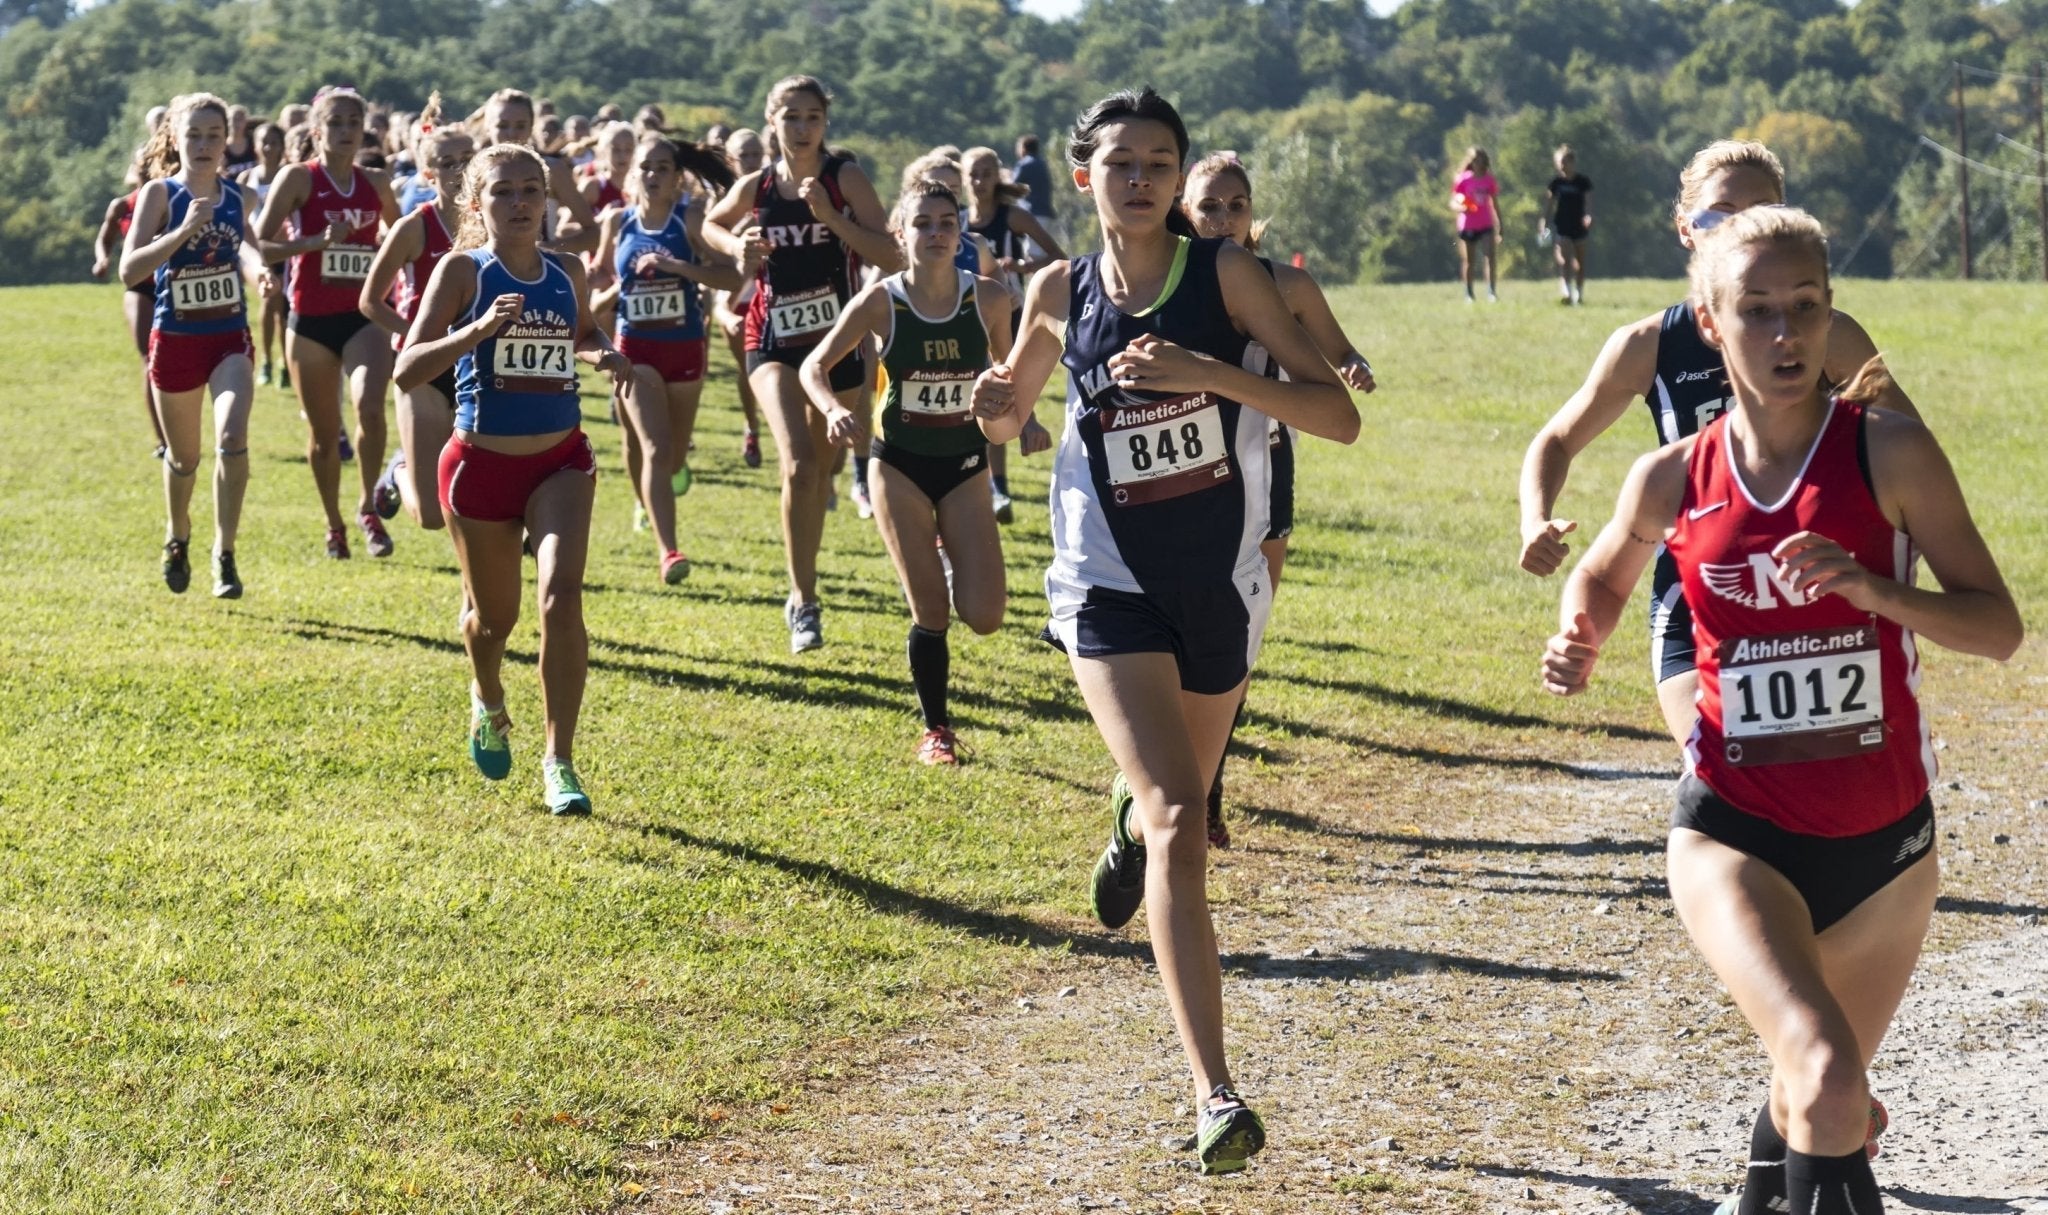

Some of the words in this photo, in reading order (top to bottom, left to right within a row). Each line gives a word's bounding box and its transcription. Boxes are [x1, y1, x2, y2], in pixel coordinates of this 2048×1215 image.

[342, 208, 362, 229] N
[767, 223, 830, 247] RYE
[177, 263, 232, 279] Athletic.net
[328, 253, 372, 274] 1002
[180, 278, 234, 304] 1080
[775, 286, 831, 307] Athletic.net
[633, 295, 679, 315] 1074
[779, 300, 835, 331] 1230
[504, 324, 570, 337] Athletic.net
[504, 343, 567, 372] 1073
[924, 338, 961, 361] FDR
[909, 370, 974, 381] Athletic.net
[1686, 371, 1710, 381] asics
[918, 384, 962, 408] 444
[1111, 391, 1207, 429] Athletic.net
[1129, 422, 1203, 471] 848
[1748, 553, 1806, 610] N
[1731, 629, 1865, 664] Athletic.net
[1737, 664, 1868, 723] 1012
